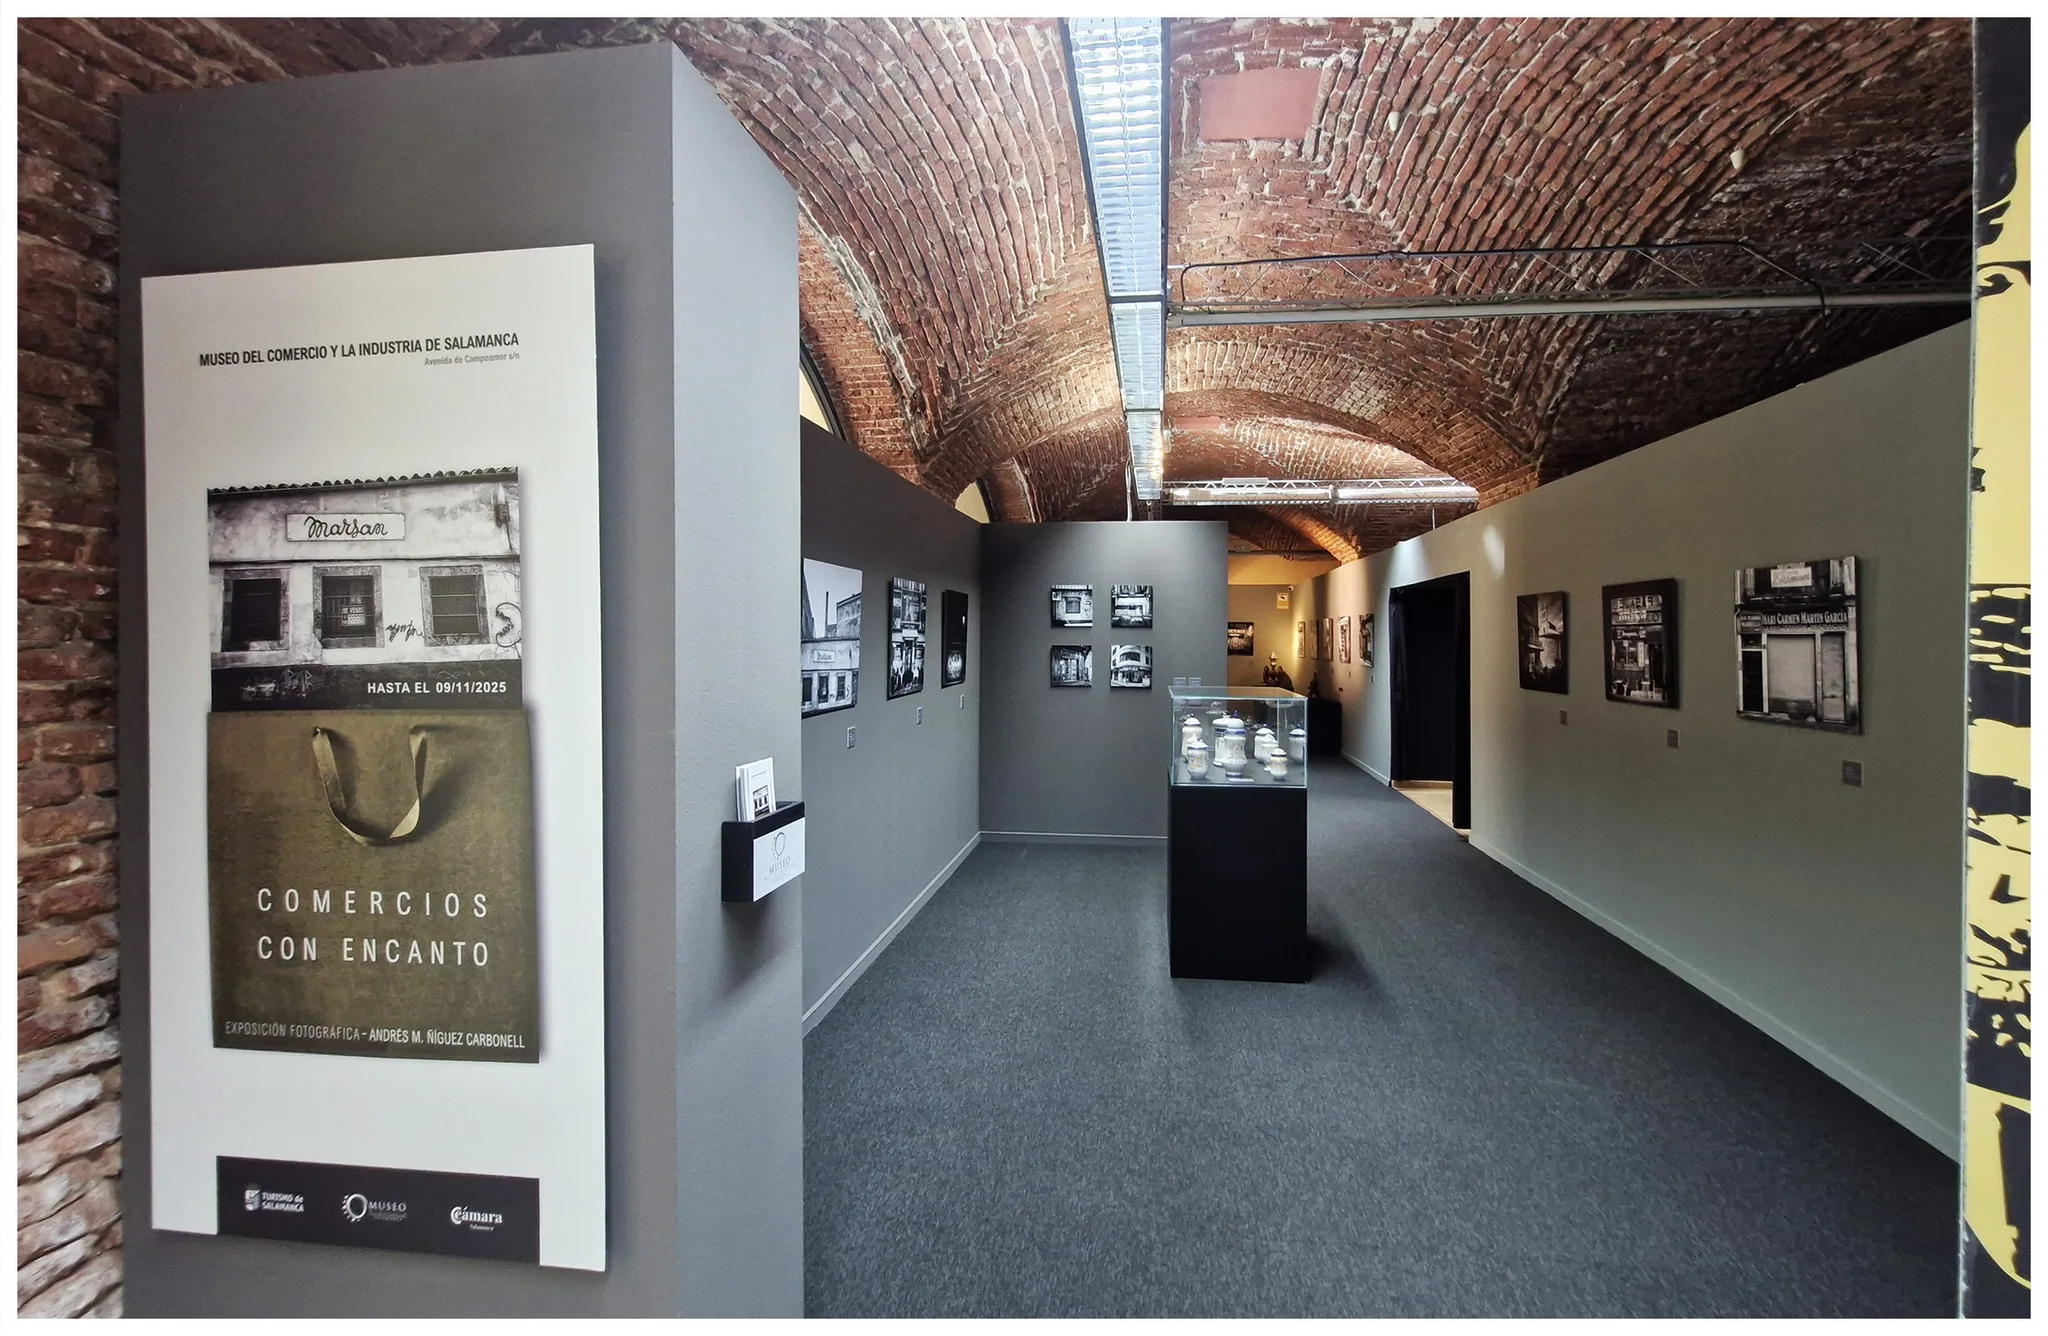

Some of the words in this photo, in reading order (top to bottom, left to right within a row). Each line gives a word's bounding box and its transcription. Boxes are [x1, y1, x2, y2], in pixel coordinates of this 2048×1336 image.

[199, 351, 240, 367] MUSEO
[243, 350, 265, 364] DEL
[267, 345, 328, 362] COMERCIO
[330, 345, 339, 358] Y
[341, 344, 356, 357] LA
[359, 339, 423, 356] INDUSTRIA
[425, 337, 441, 352] DE
[444, 332, 519, 350] SALAMANCA
[424, 356, 453, 366] Avenida
[454, 355, 463, 364] de
[464, 353, 507, 364] Campoamor
[508, 352, 520, 360] s/n
[303, 516, 388, 539] Marsan
[1777, 612, 1800, 625] CARMEN
[367, 682, 410, 694] HASTA
[414, 682, 430, 693] EL
[435, 681, 507, 694] 09/11/2025
[257, 888, 488, 918] COMERCIOS
[258, 936, 317, 961] CON
[343, 937, 488, 967] ENCANTO
[225, 1021, 287, 1037] EXPOSICIÓN
[368, 1028, 409, 1043] ANDRÉS
[411, 1030, 424, 1044] M.
[427, 1028, 464, 1046] ÑÍGUEZ
[466, 1032, 526, 1048] CARBONELL
[261, 1192, 293, 1203] TURISMO
[368, 1200, 407, 1212] MUSEO
[261, 1201, 304, 1213] SALAMANCA
[450, 1205, 503, 1225] Cámara
